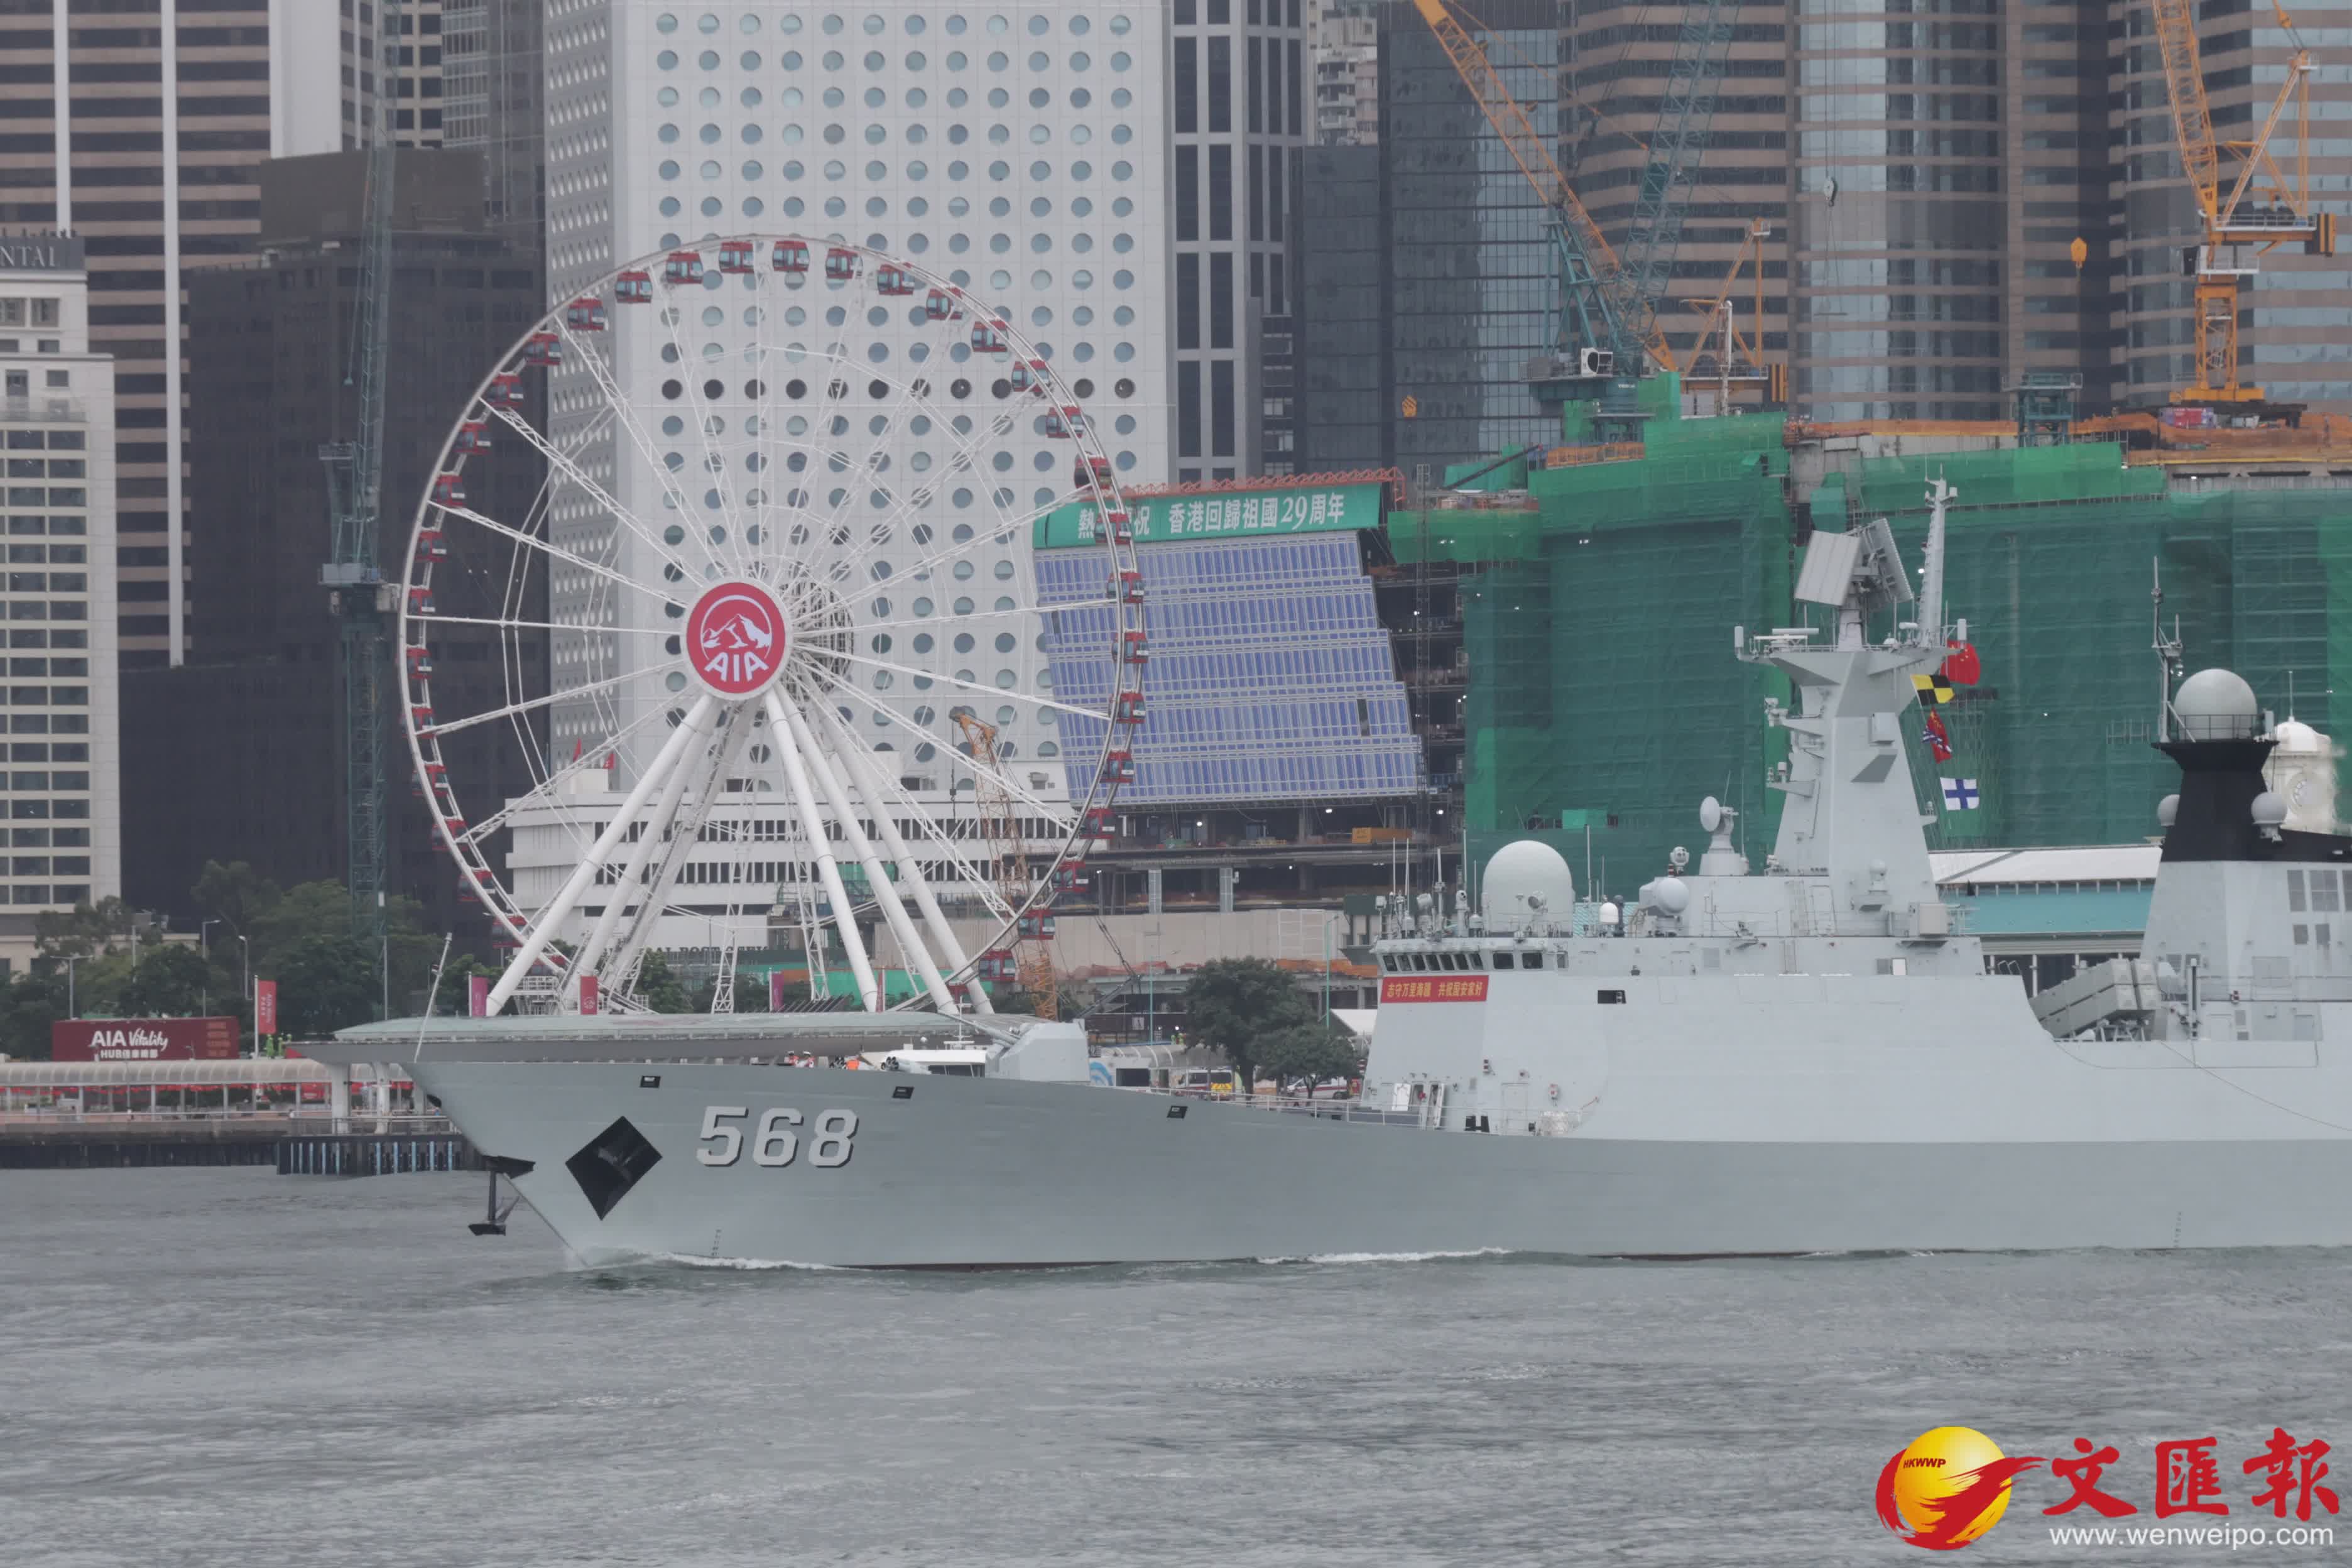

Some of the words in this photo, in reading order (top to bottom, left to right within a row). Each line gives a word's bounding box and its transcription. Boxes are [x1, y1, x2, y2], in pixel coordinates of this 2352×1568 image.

[1077, 506, 1150, 539] 熱祝
[1168, 492, 1344, 534] 香港回歸祖國29周年
[704, 651, 769, 682] AIA
[90, 1030, 127, 1047] AIA
[128, 1028, 168, 1052] Vitality
[696, 1106, 860, 1168] 568
